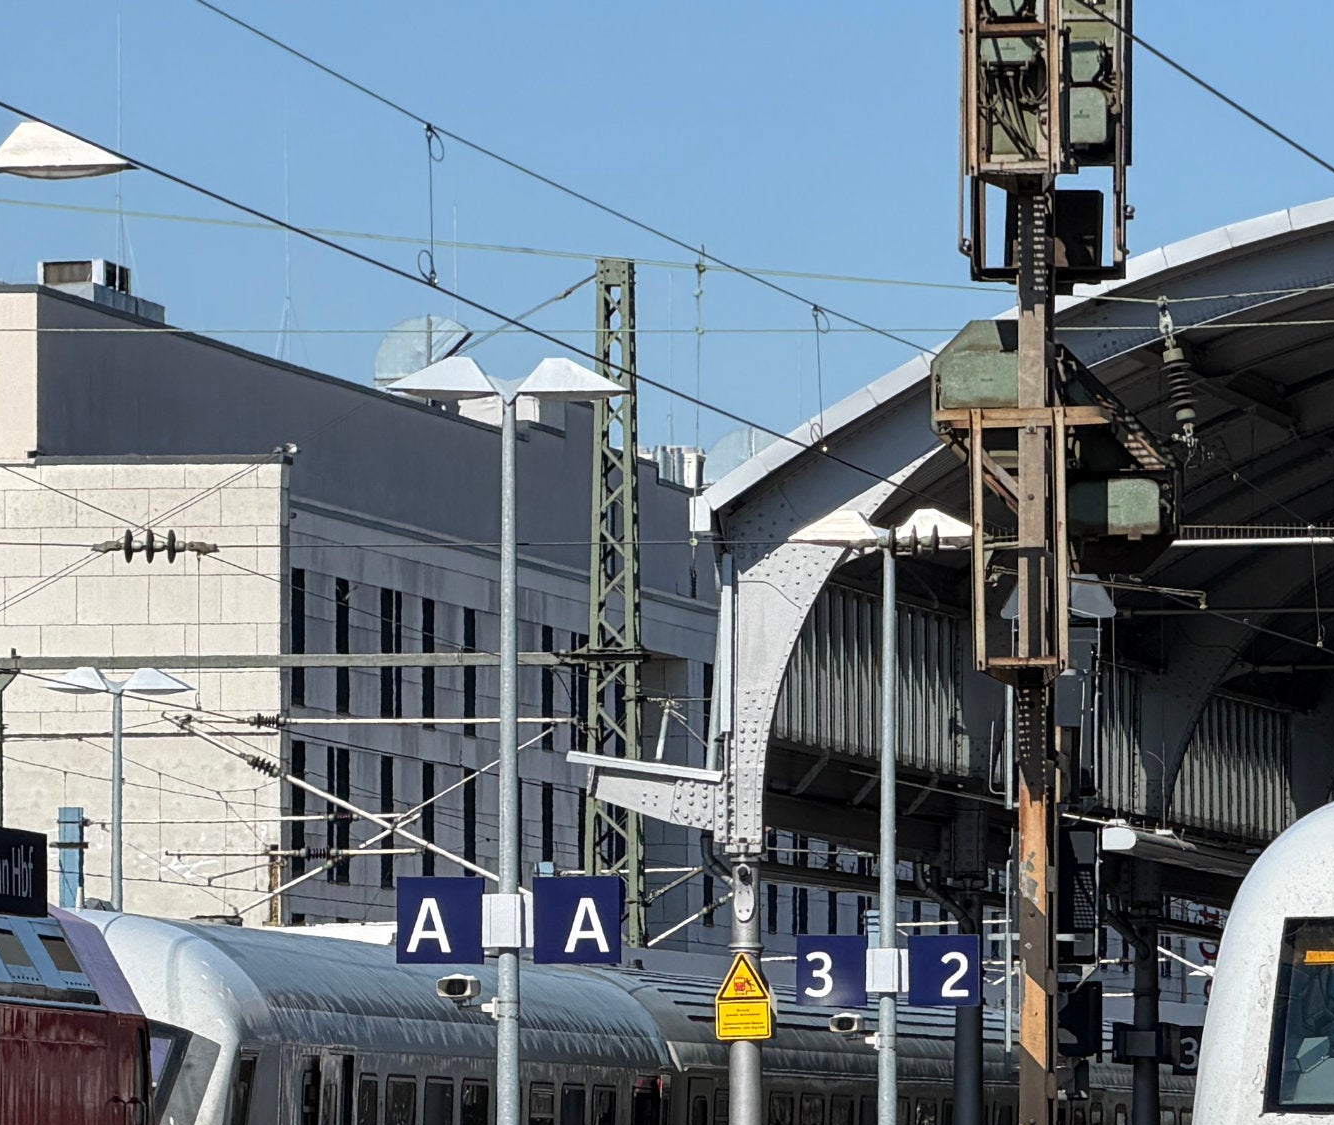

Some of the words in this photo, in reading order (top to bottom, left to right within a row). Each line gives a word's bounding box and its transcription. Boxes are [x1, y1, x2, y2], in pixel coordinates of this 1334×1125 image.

[12, 844, 34, 898] Hbf
[406, 897, 452, 953] A
[564, 897, 610, 953] A
[804, 951, 834, 998] 3
[940, 951, 969, 998] 2
[1180, 1037, 1199, 1070] 3
